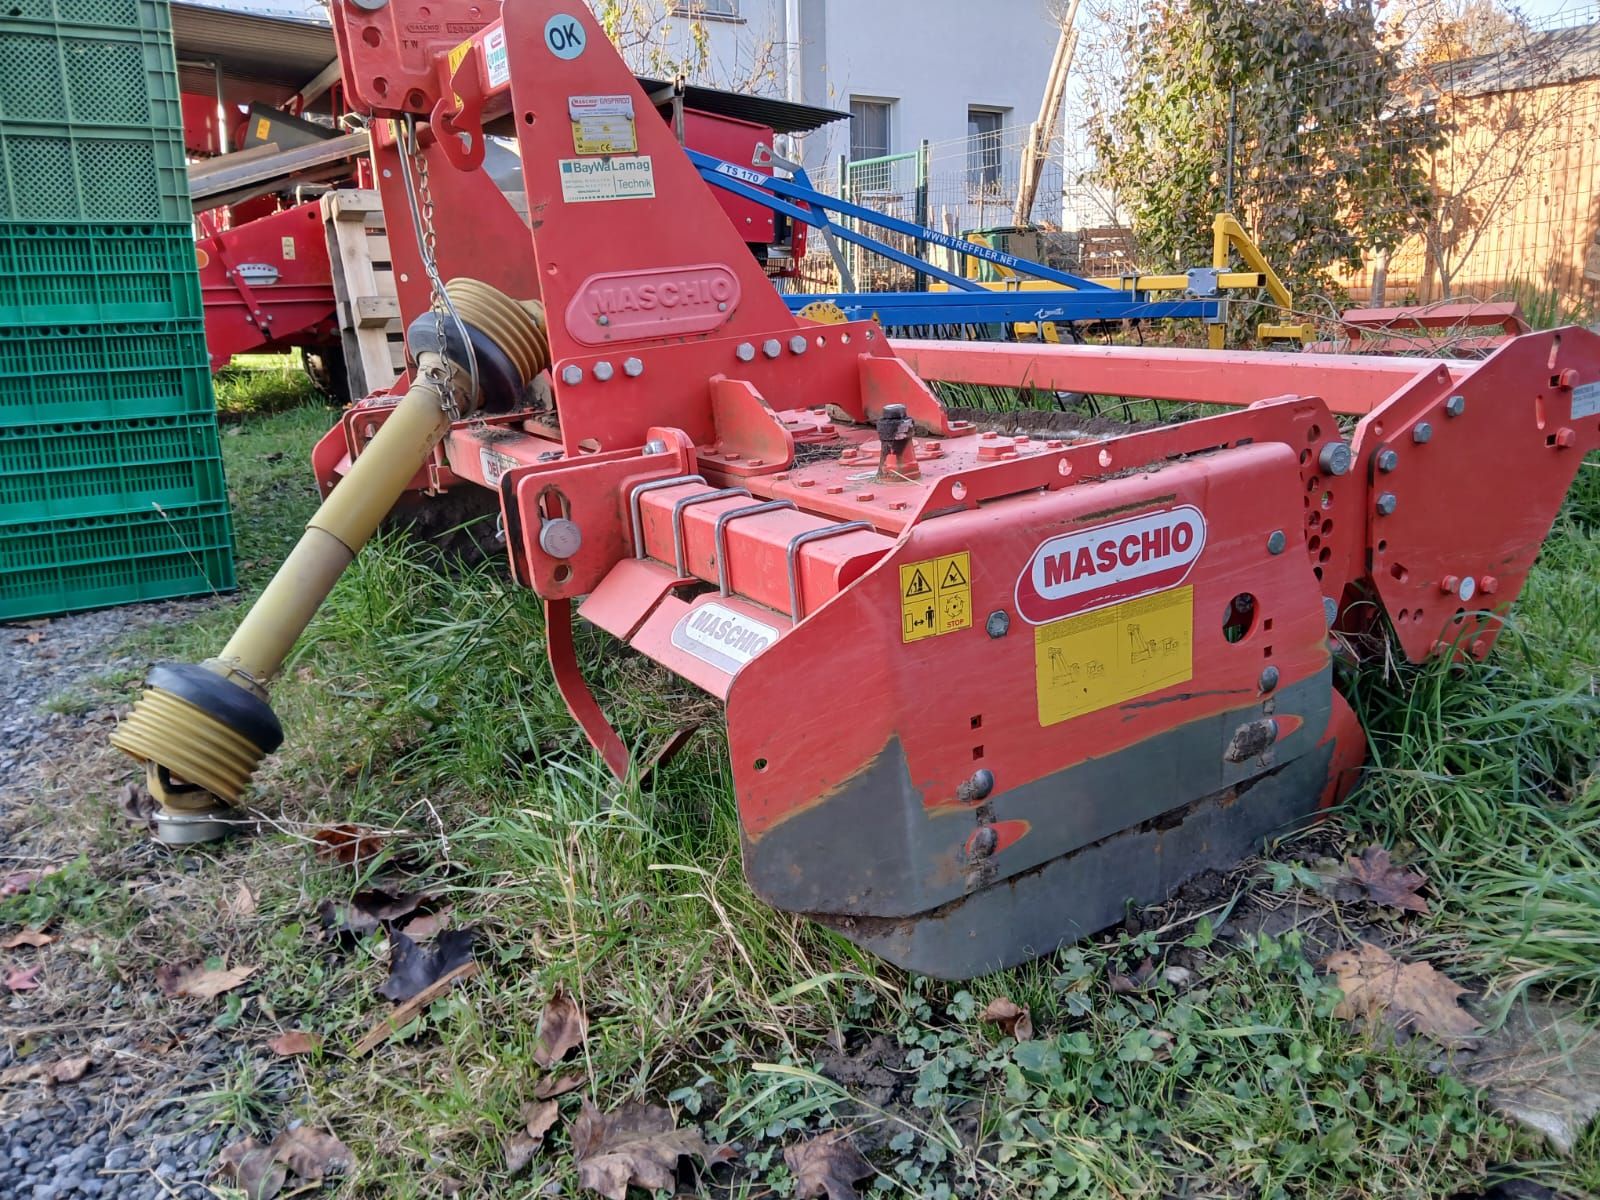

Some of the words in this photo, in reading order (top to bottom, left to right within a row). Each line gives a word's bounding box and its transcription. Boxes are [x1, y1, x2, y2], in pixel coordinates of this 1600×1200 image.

[549, 22, 582, 51] OK
[572, 160, 611, 175] BayWa
[611, 160, 651, 172] Lamag
[725, 164, 739, 177] TS
[741, 171, 760, 183] 170
[617, 178, 653, 190] Technik
[922, 227, 1019, 268] WWW.TREFFLER.NET
[588, 275, 733, 316] MASCHIO
[1043, 520, 1194, 588] MASCHIO
[690, 610, 769, 658] MASCHIO
[946, 618, 965, 629] STOP
